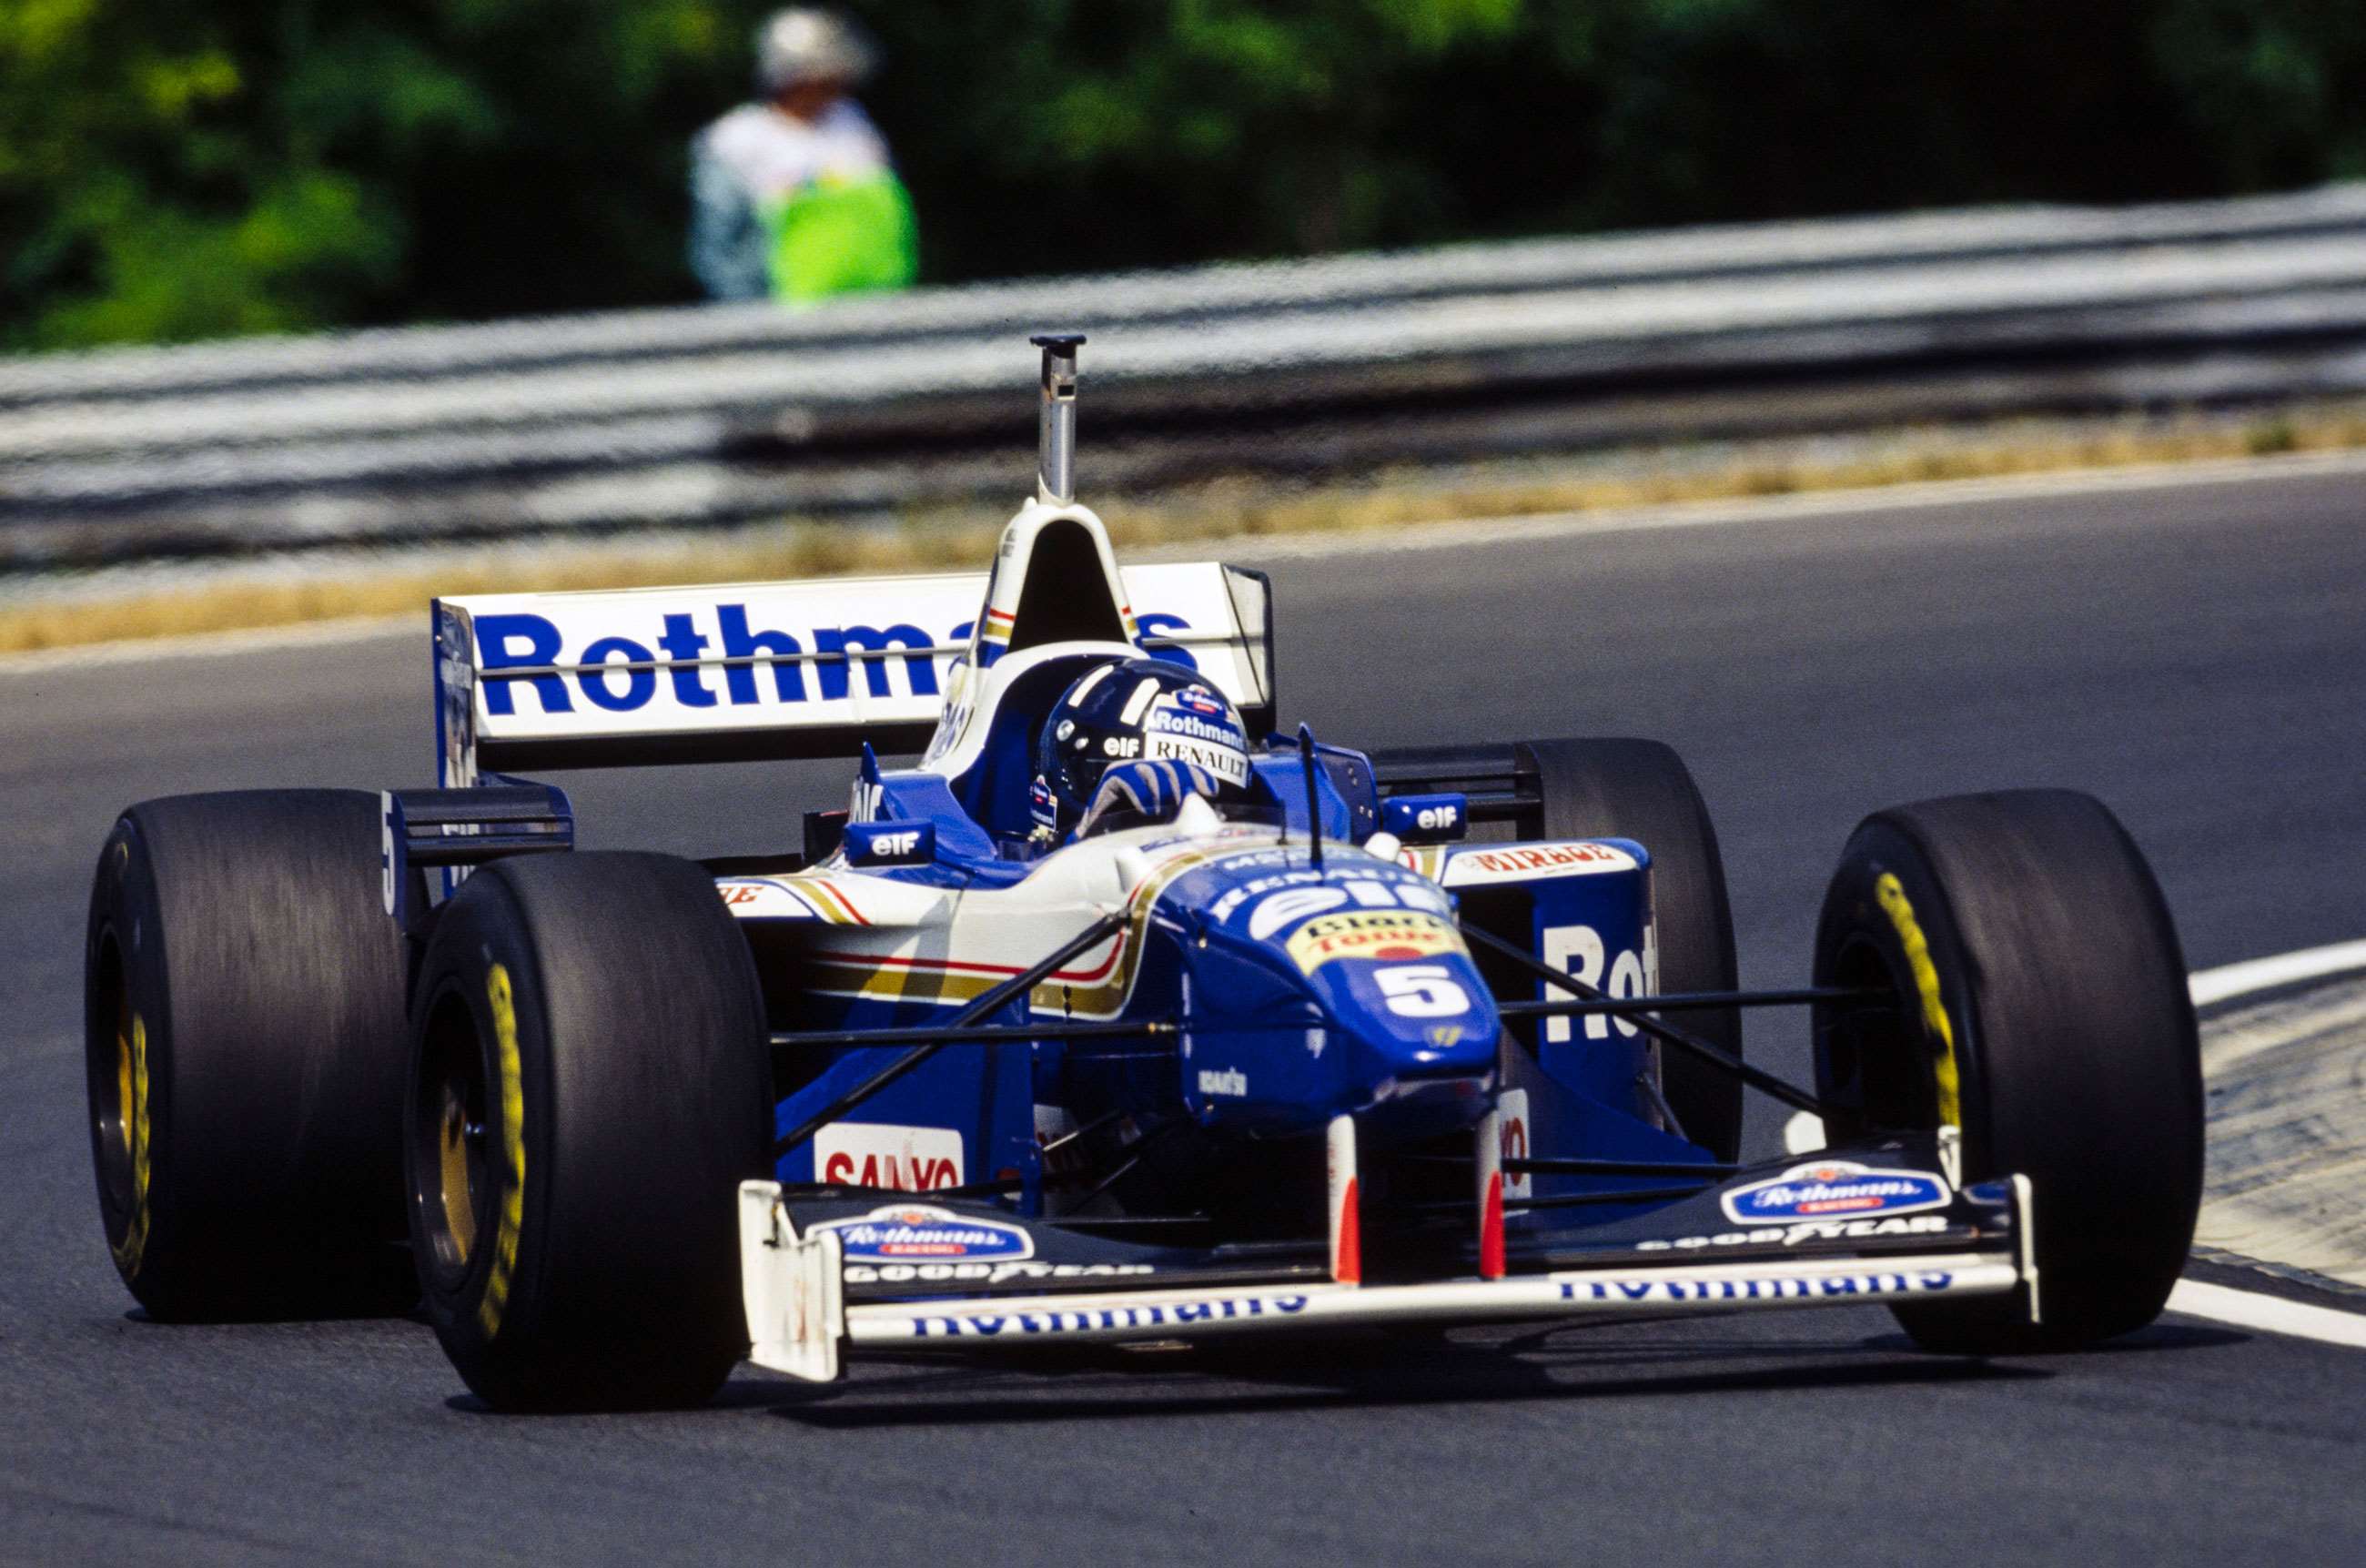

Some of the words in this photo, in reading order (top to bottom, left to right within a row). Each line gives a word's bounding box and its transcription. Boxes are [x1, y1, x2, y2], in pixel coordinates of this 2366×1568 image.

[473, 604, 1198, 714] Rothms
[1104, 736, 1139, 757] elf
[1156, 741, 1245, 779] RENAULT
[1417, 804, 1458, 829] elf
[871, 832, 919, 856] elf
[1373, 966, 1471, 1017] 5
[1753, 1179, 1922, 1208] Rothmans
[842, 1227, 1006, 1247] Rothmans
[1635, 1216, 1948, 1250] GOODYEAR
[844, 1261, 1155, 1283] GOODYEAR
